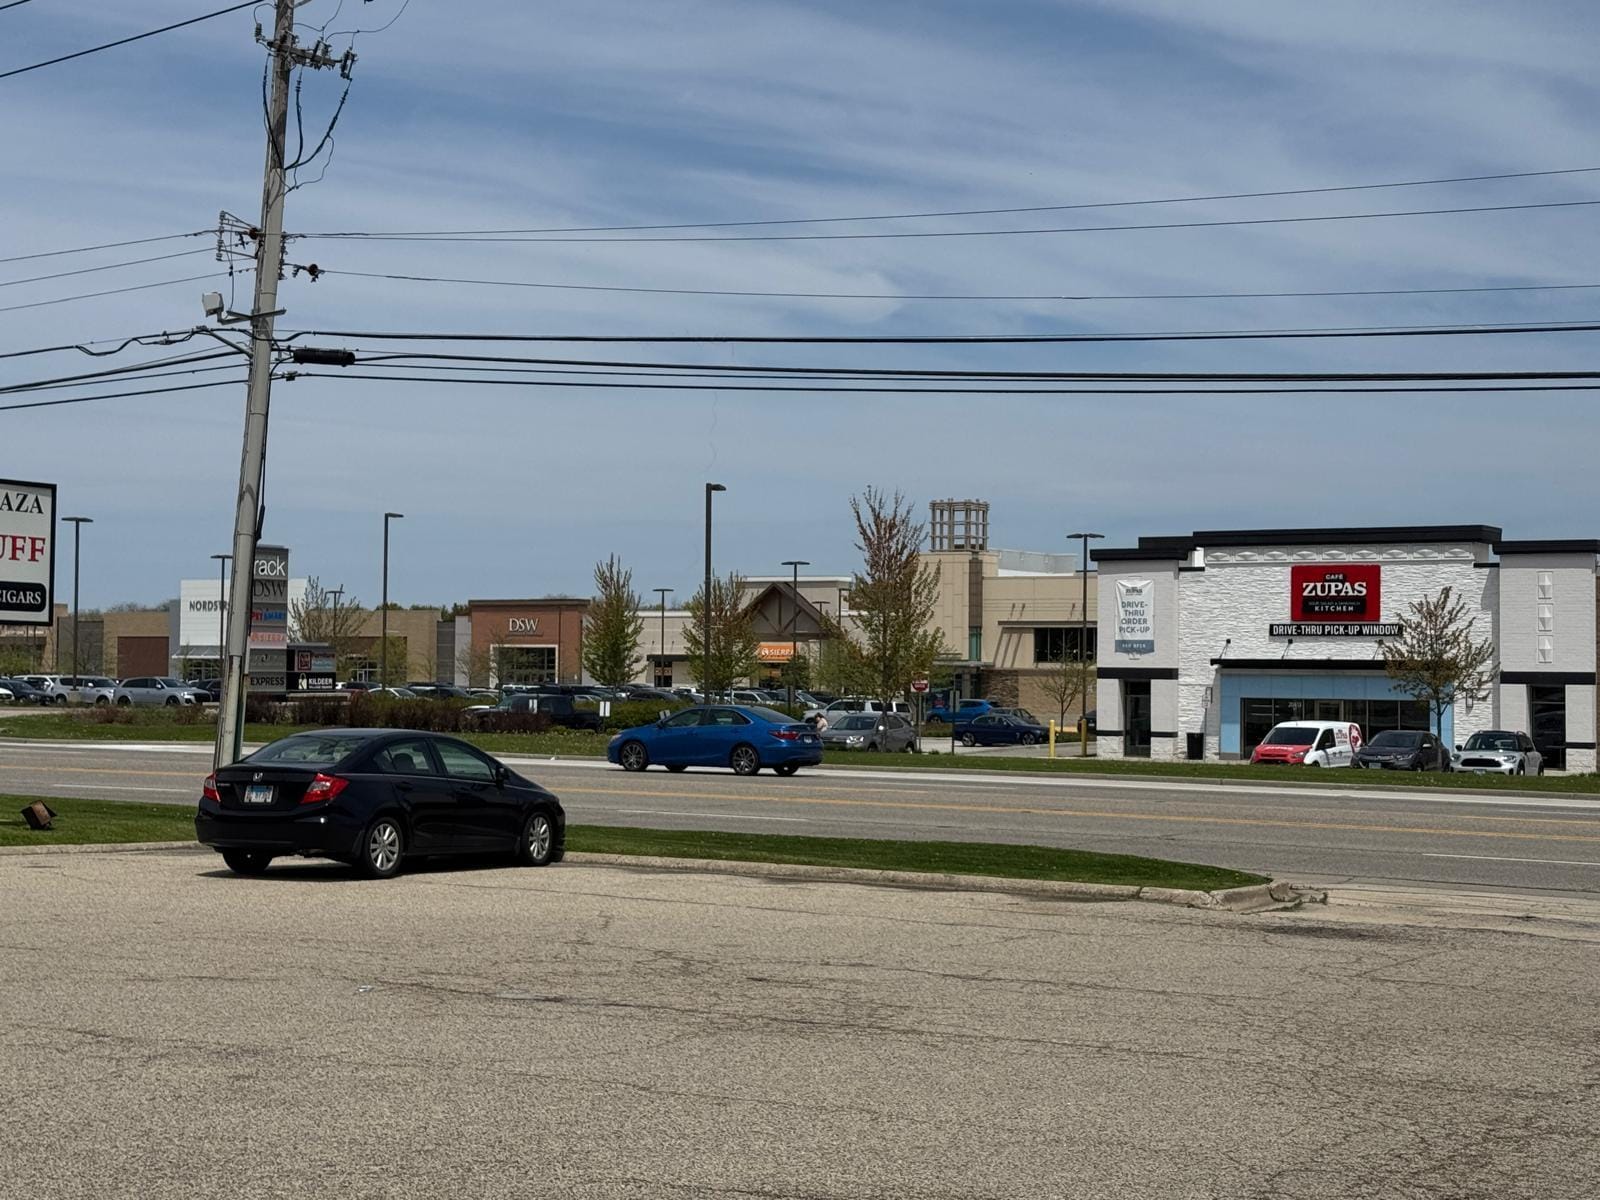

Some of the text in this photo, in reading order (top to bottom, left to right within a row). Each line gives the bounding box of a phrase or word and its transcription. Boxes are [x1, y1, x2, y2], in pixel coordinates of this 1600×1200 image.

[253, 556, 286, 576] rack
[253, 580, 286, 597] DSW
[1302, 582, 1367, 596] ZUPAS
[1121, 601, 1148, 609] DRIVE-
[1124, 609, 1144, 617] THRU
[509, 618, 538, 631] DSW
[1120, 617, 1148, 625] ORDER
[1119, 626, 1151, 634] PICK-UP
[1273, 624, 1399, 635] DRIVE-THRU PICK-UP WINDOW
[251, 676, 285, 686] EXPRESS
